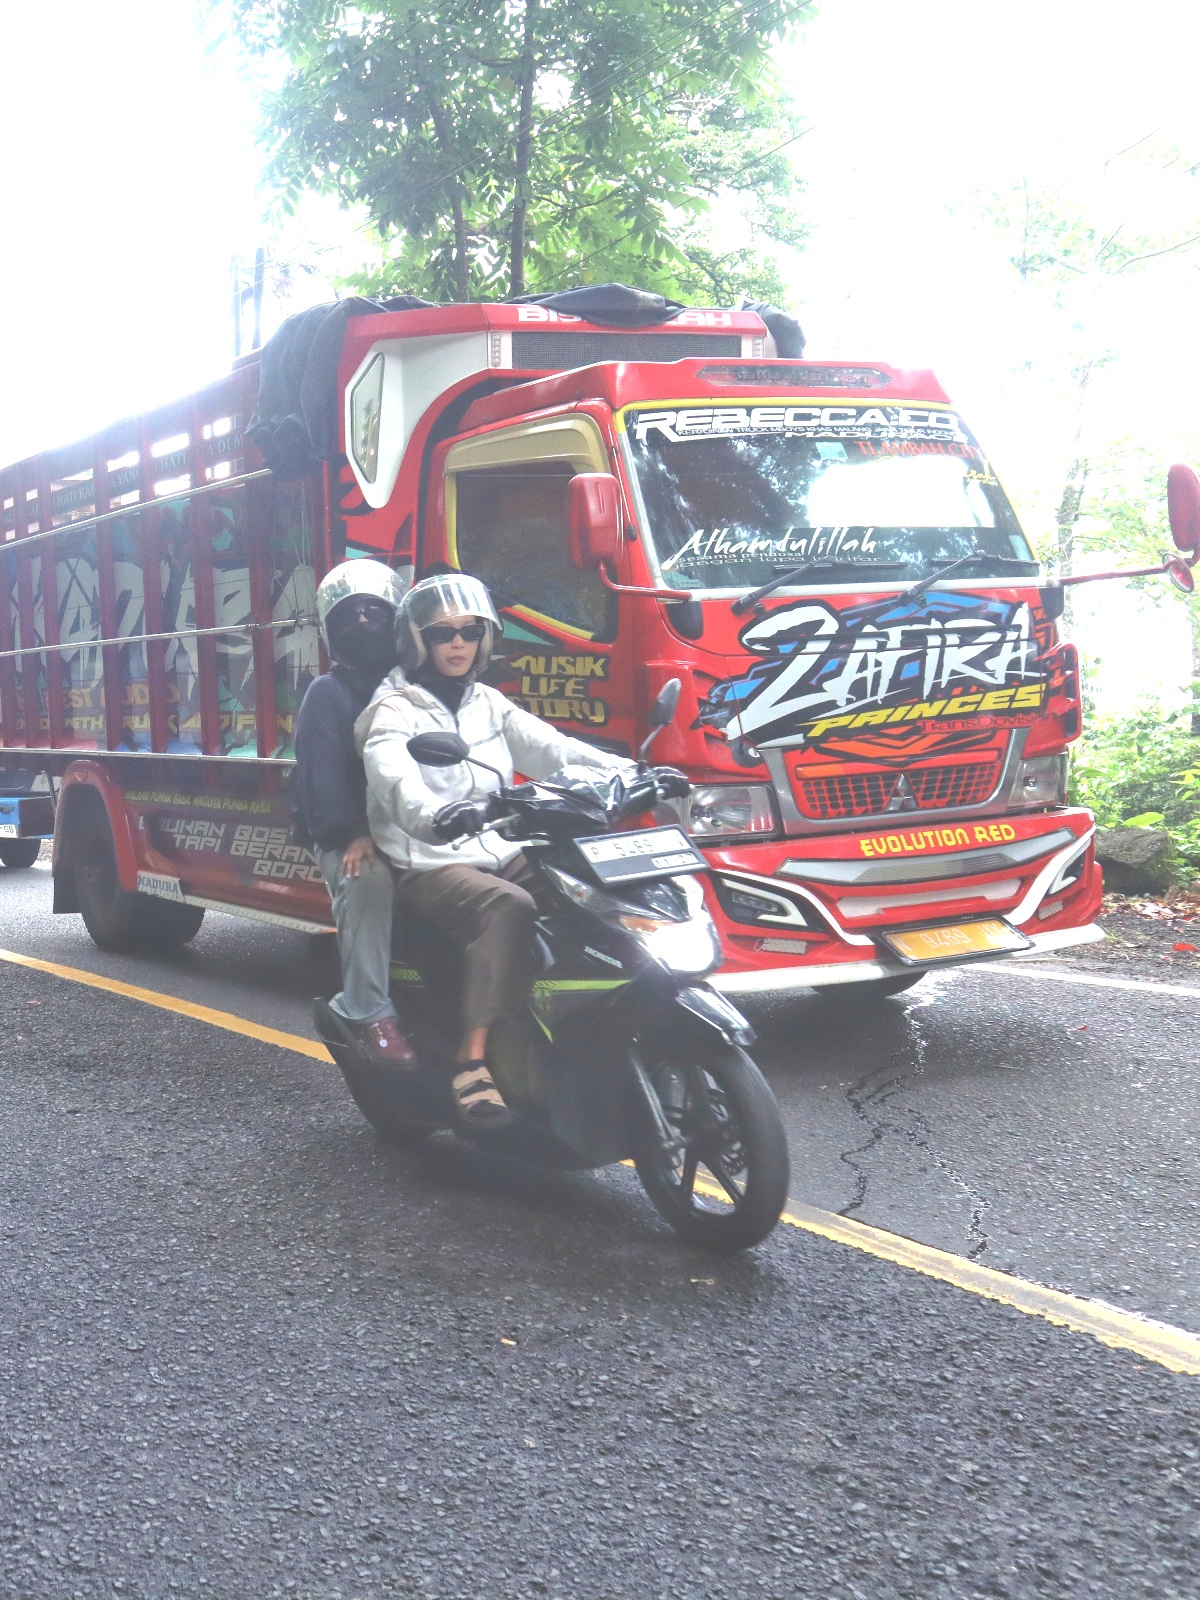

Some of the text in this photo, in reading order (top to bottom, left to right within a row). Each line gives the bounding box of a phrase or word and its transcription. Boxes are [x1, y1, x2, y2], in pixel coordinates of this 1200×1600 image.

[517, 308, 731, 326] BISAH
[522, 676, 586, 697] LIFE
[799, 682, 1046, 737] PRINCES
[161, 818, 288, 844] UKAN BOS
[861, 824, 1016, 856] EVOLUTION RED
[173, 834, 222, 852] TAPI
[137, 876, 179, 894] MADURA
